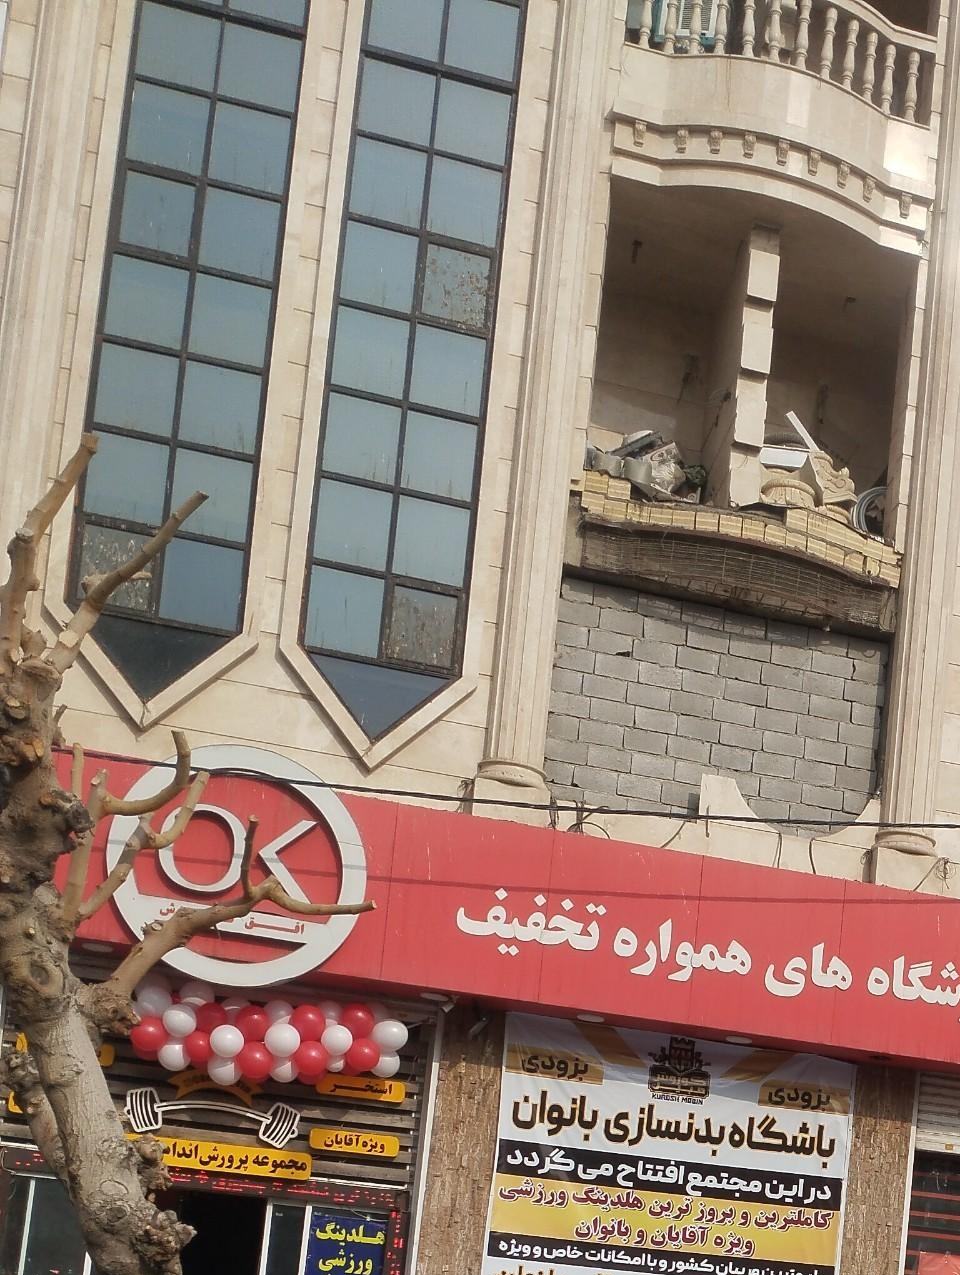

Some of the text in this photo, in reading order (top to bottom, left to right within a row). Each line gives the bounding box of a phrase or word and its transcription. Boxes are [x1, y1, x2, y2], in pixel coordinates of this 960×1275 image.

[157, 803, 320, 906] OK
[456, 887, 607, 957] تخفیف
[613, 917, 752, 982] همواره
[764, 942, 853, 998] های
[521, 1055, 589, 1083] بزودی
[330, 1081, 393, 1096] استخر
[767, 1085, 832, 1111] بزودی
[511, 1090, 837, 1170] باشگاه بدنسازی بانوان
[323, 1134, 386, 1154] ویژه آقایان
[199, 1145, 250, 1172] پرورش
[252, 1154, 308, 1176] مجموعه
[506, 1148, 832, 1205] در این مجتمع افتتاح می گردد
[498, 1178, 834, 1230] کاملترین و بروز ترین هلدینگ ورزشی
[315, 1222, 386, 1246] هلدینگ
[574, 1215, 756, 1257] ویژه آقایان و بانوان
[498, 1239, 532, 1257] ویژه
[532, 1245, 542, 1260] و
[543, 1245, 584, 1260] خاص
[584, 1248, 646, 1266] امکانات
[319, 1248, 373, 1275] ورزشی
[647, 1253, 658, 1272] با
[659, 1258, 667, 1273] و
[670, 1257, 715, 1274] کشور
